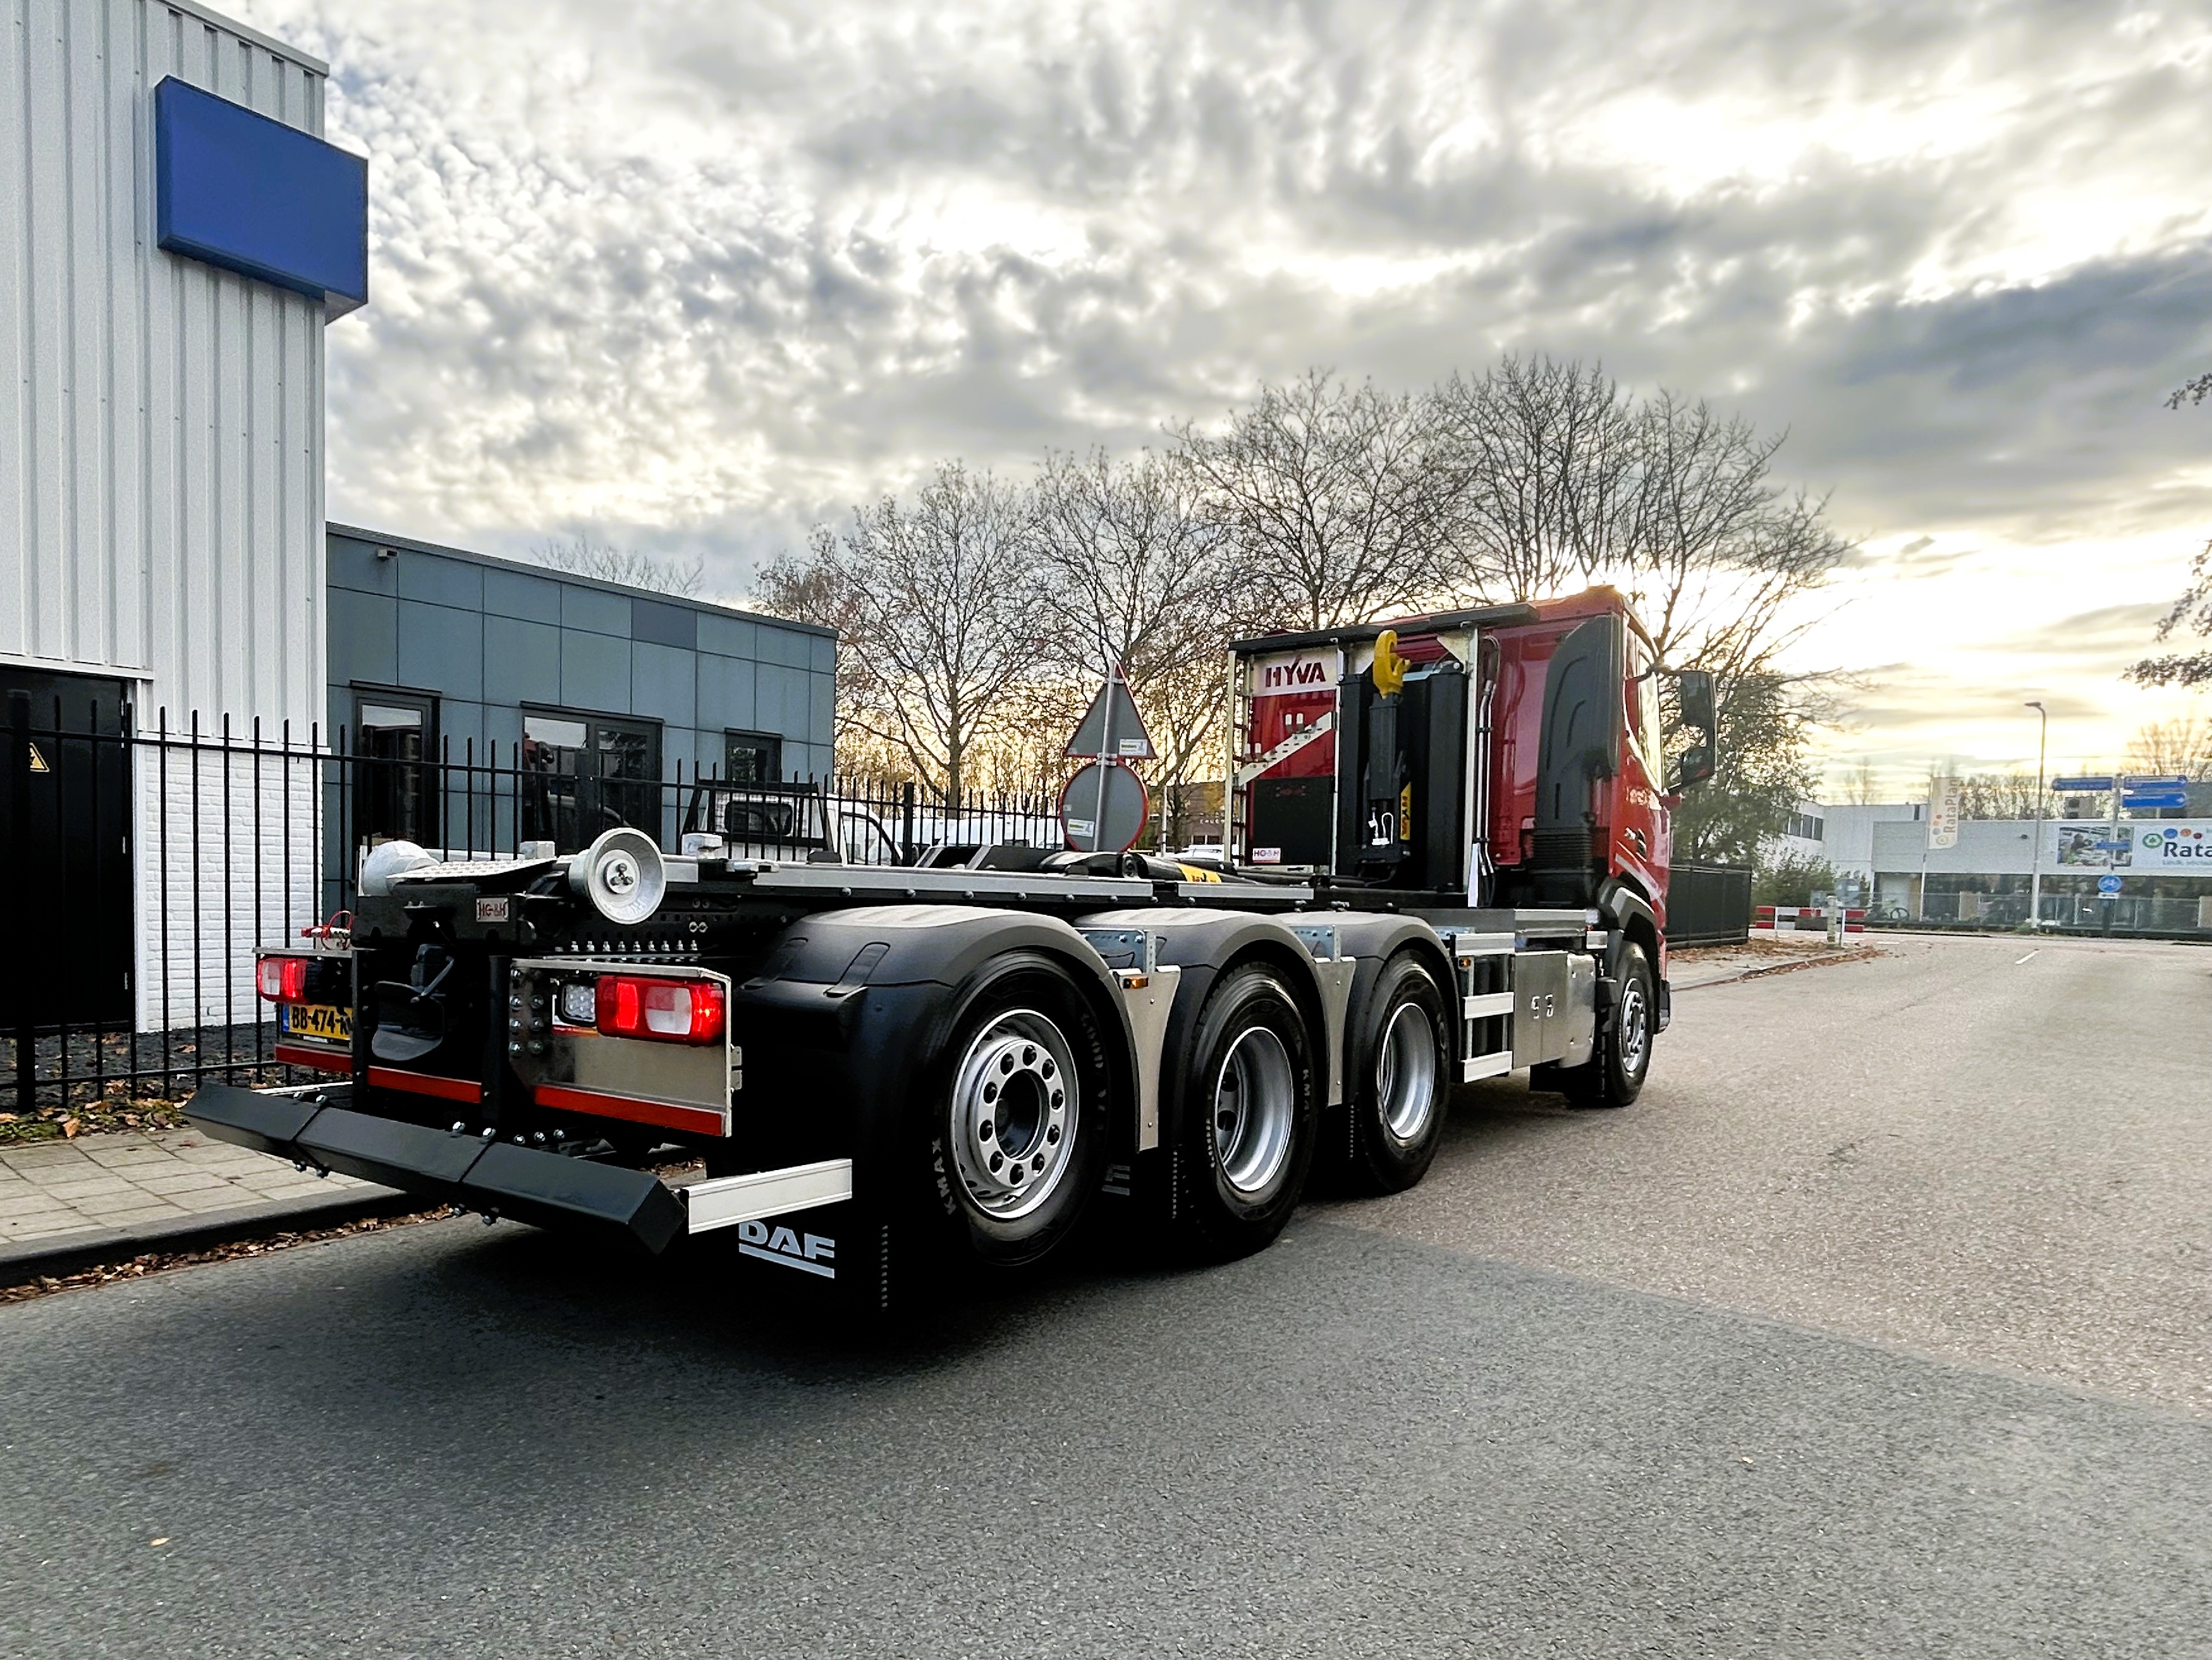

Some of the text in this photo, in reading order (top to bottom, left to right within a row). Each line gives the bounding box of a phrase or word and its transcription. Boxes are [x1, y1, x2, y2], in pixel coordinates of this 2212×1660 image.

[1266, 653, 1326, 688] HYVA
[1943, 779, 1958, 833] RataPlan
[2163, 842, 2212, 857] Rata
[738, 1220, 835, 1260] DAF
